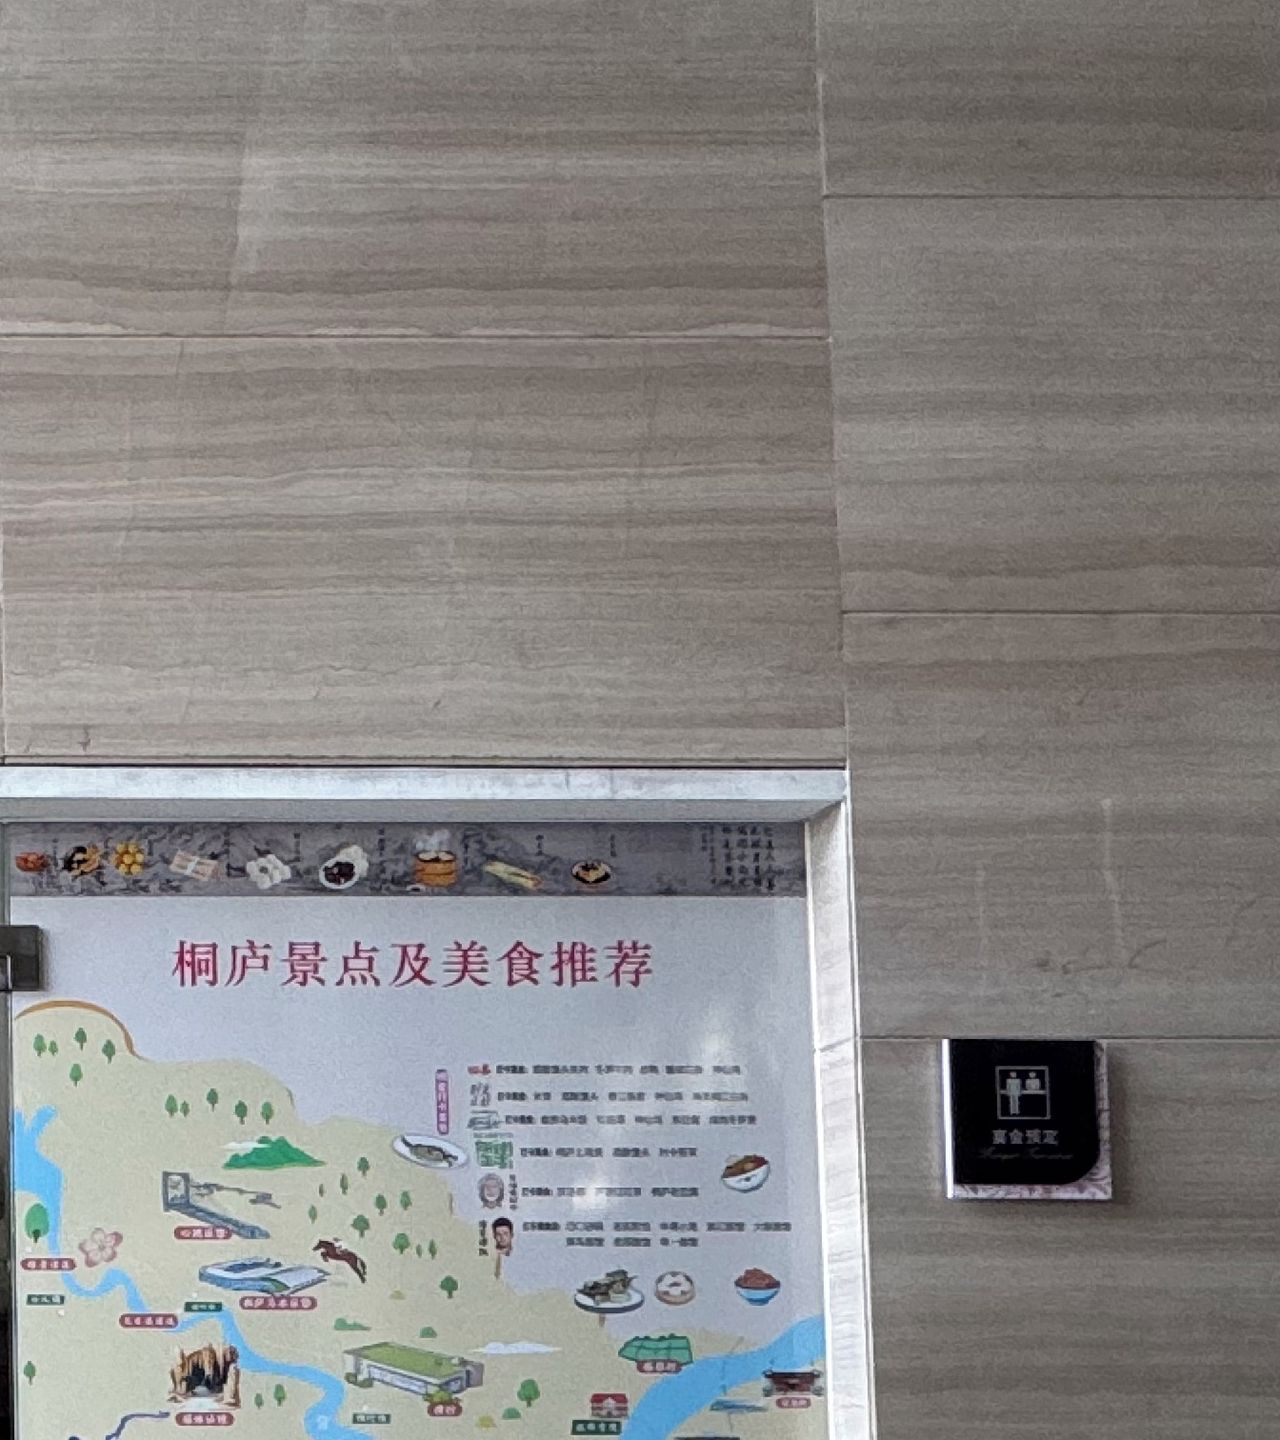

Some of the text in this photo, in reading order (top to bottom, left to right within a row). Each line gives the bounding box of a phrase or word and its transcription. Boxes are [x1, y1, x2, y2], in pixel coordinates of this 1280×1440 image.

[172, 939, 653, 988] 桐庐景点及美食推荐
